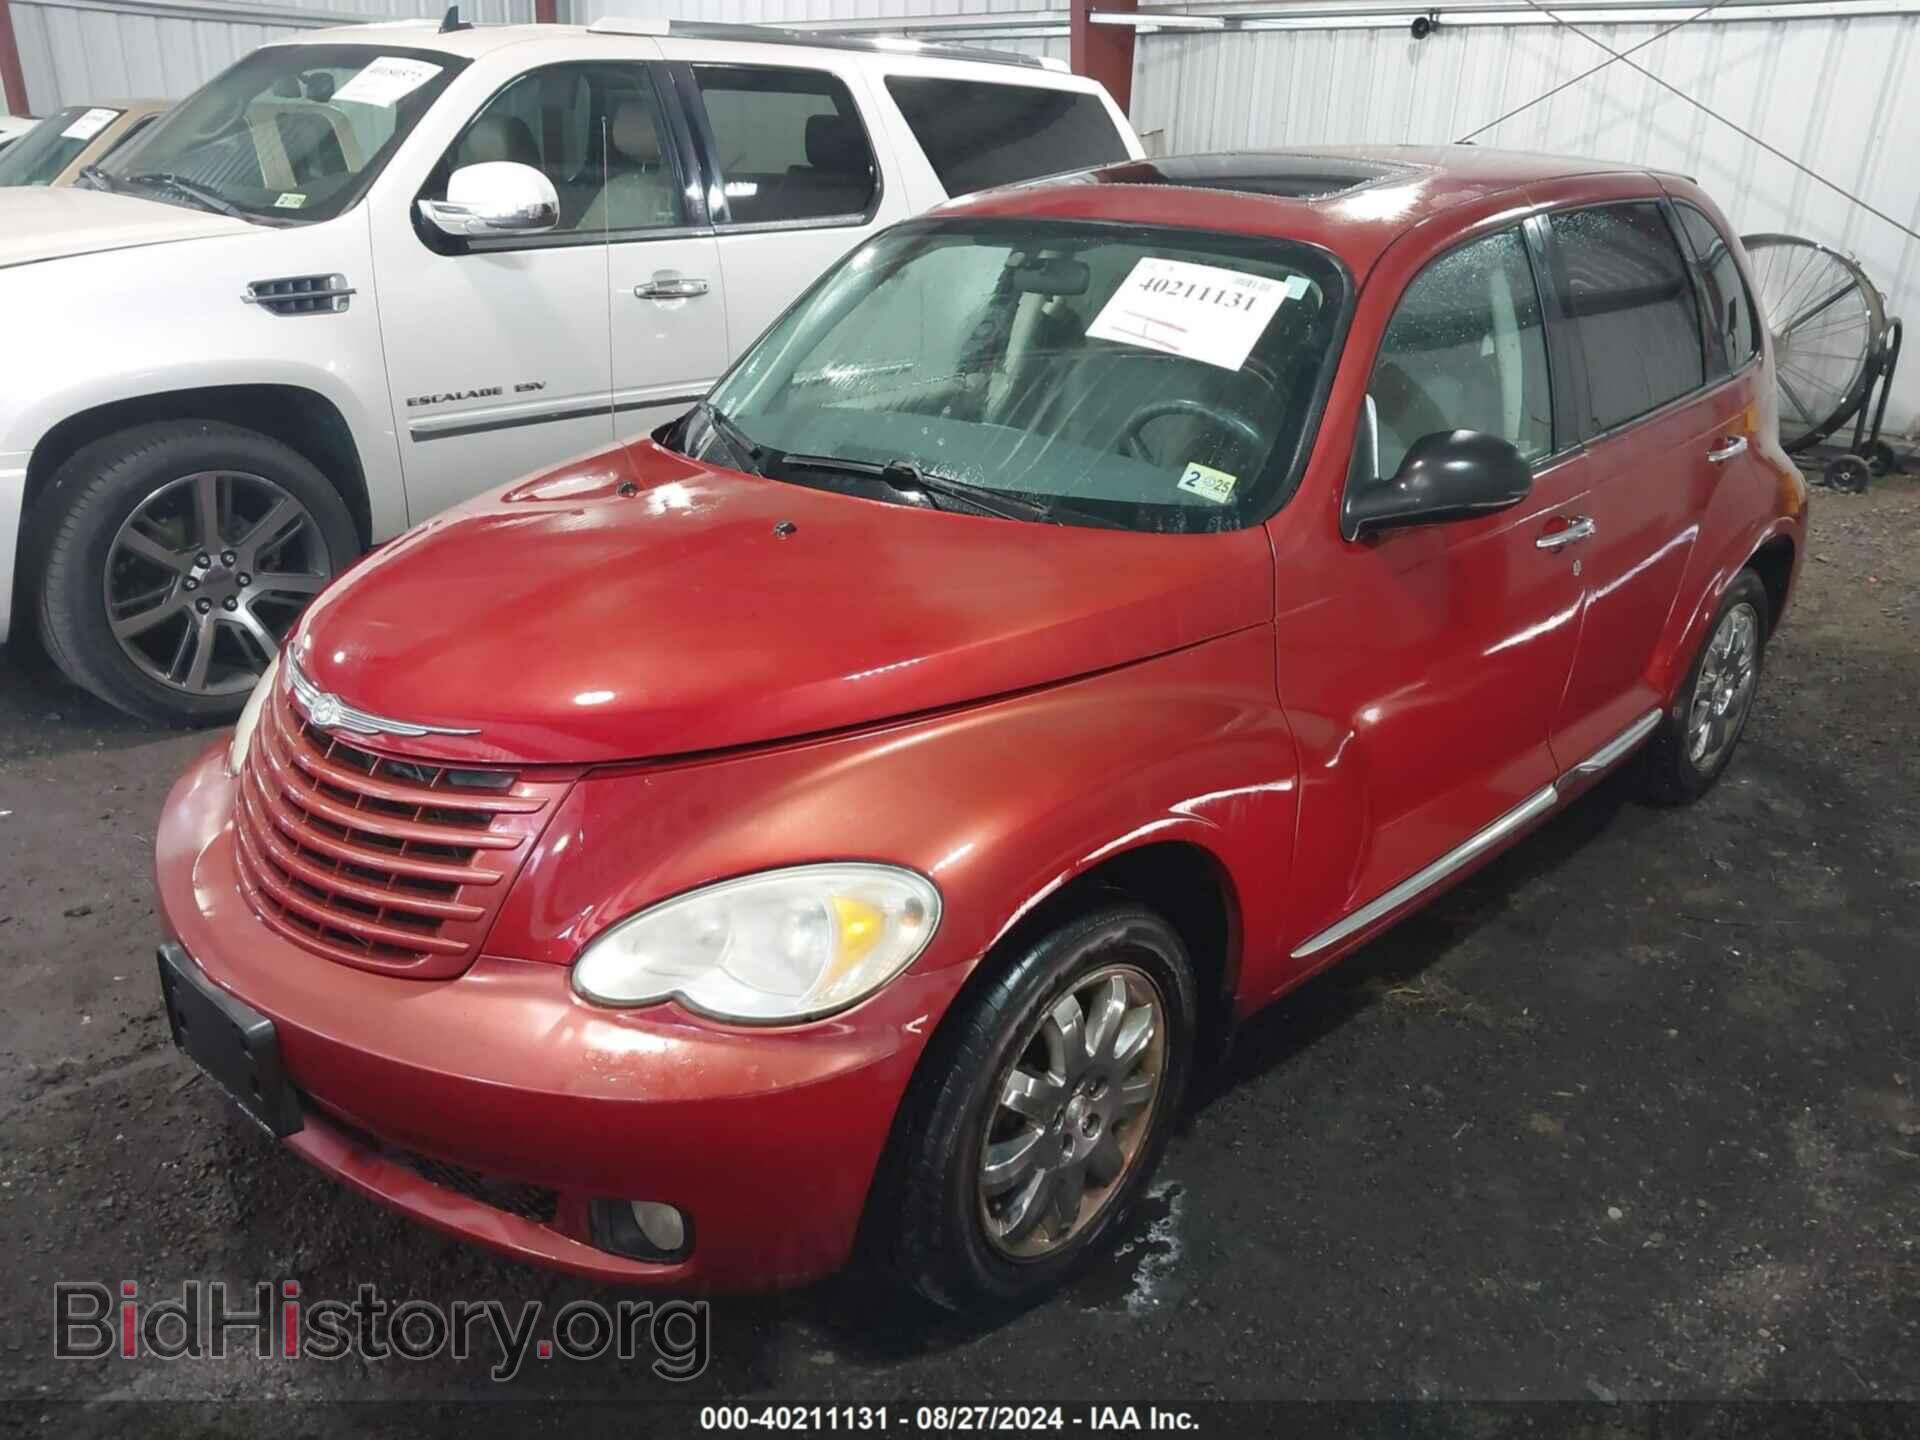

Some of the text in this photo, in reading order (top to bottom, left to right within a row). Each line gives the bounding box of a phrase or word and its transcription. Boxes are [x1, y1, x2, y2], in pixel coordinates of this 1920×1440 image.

[1138, 276, 1257, 313] 40211131
[406, 381, 547, 407] ESCALADE ESV
[1185, 470, 1201, 488] 2
[1214, 479, 1232, 494] 25
